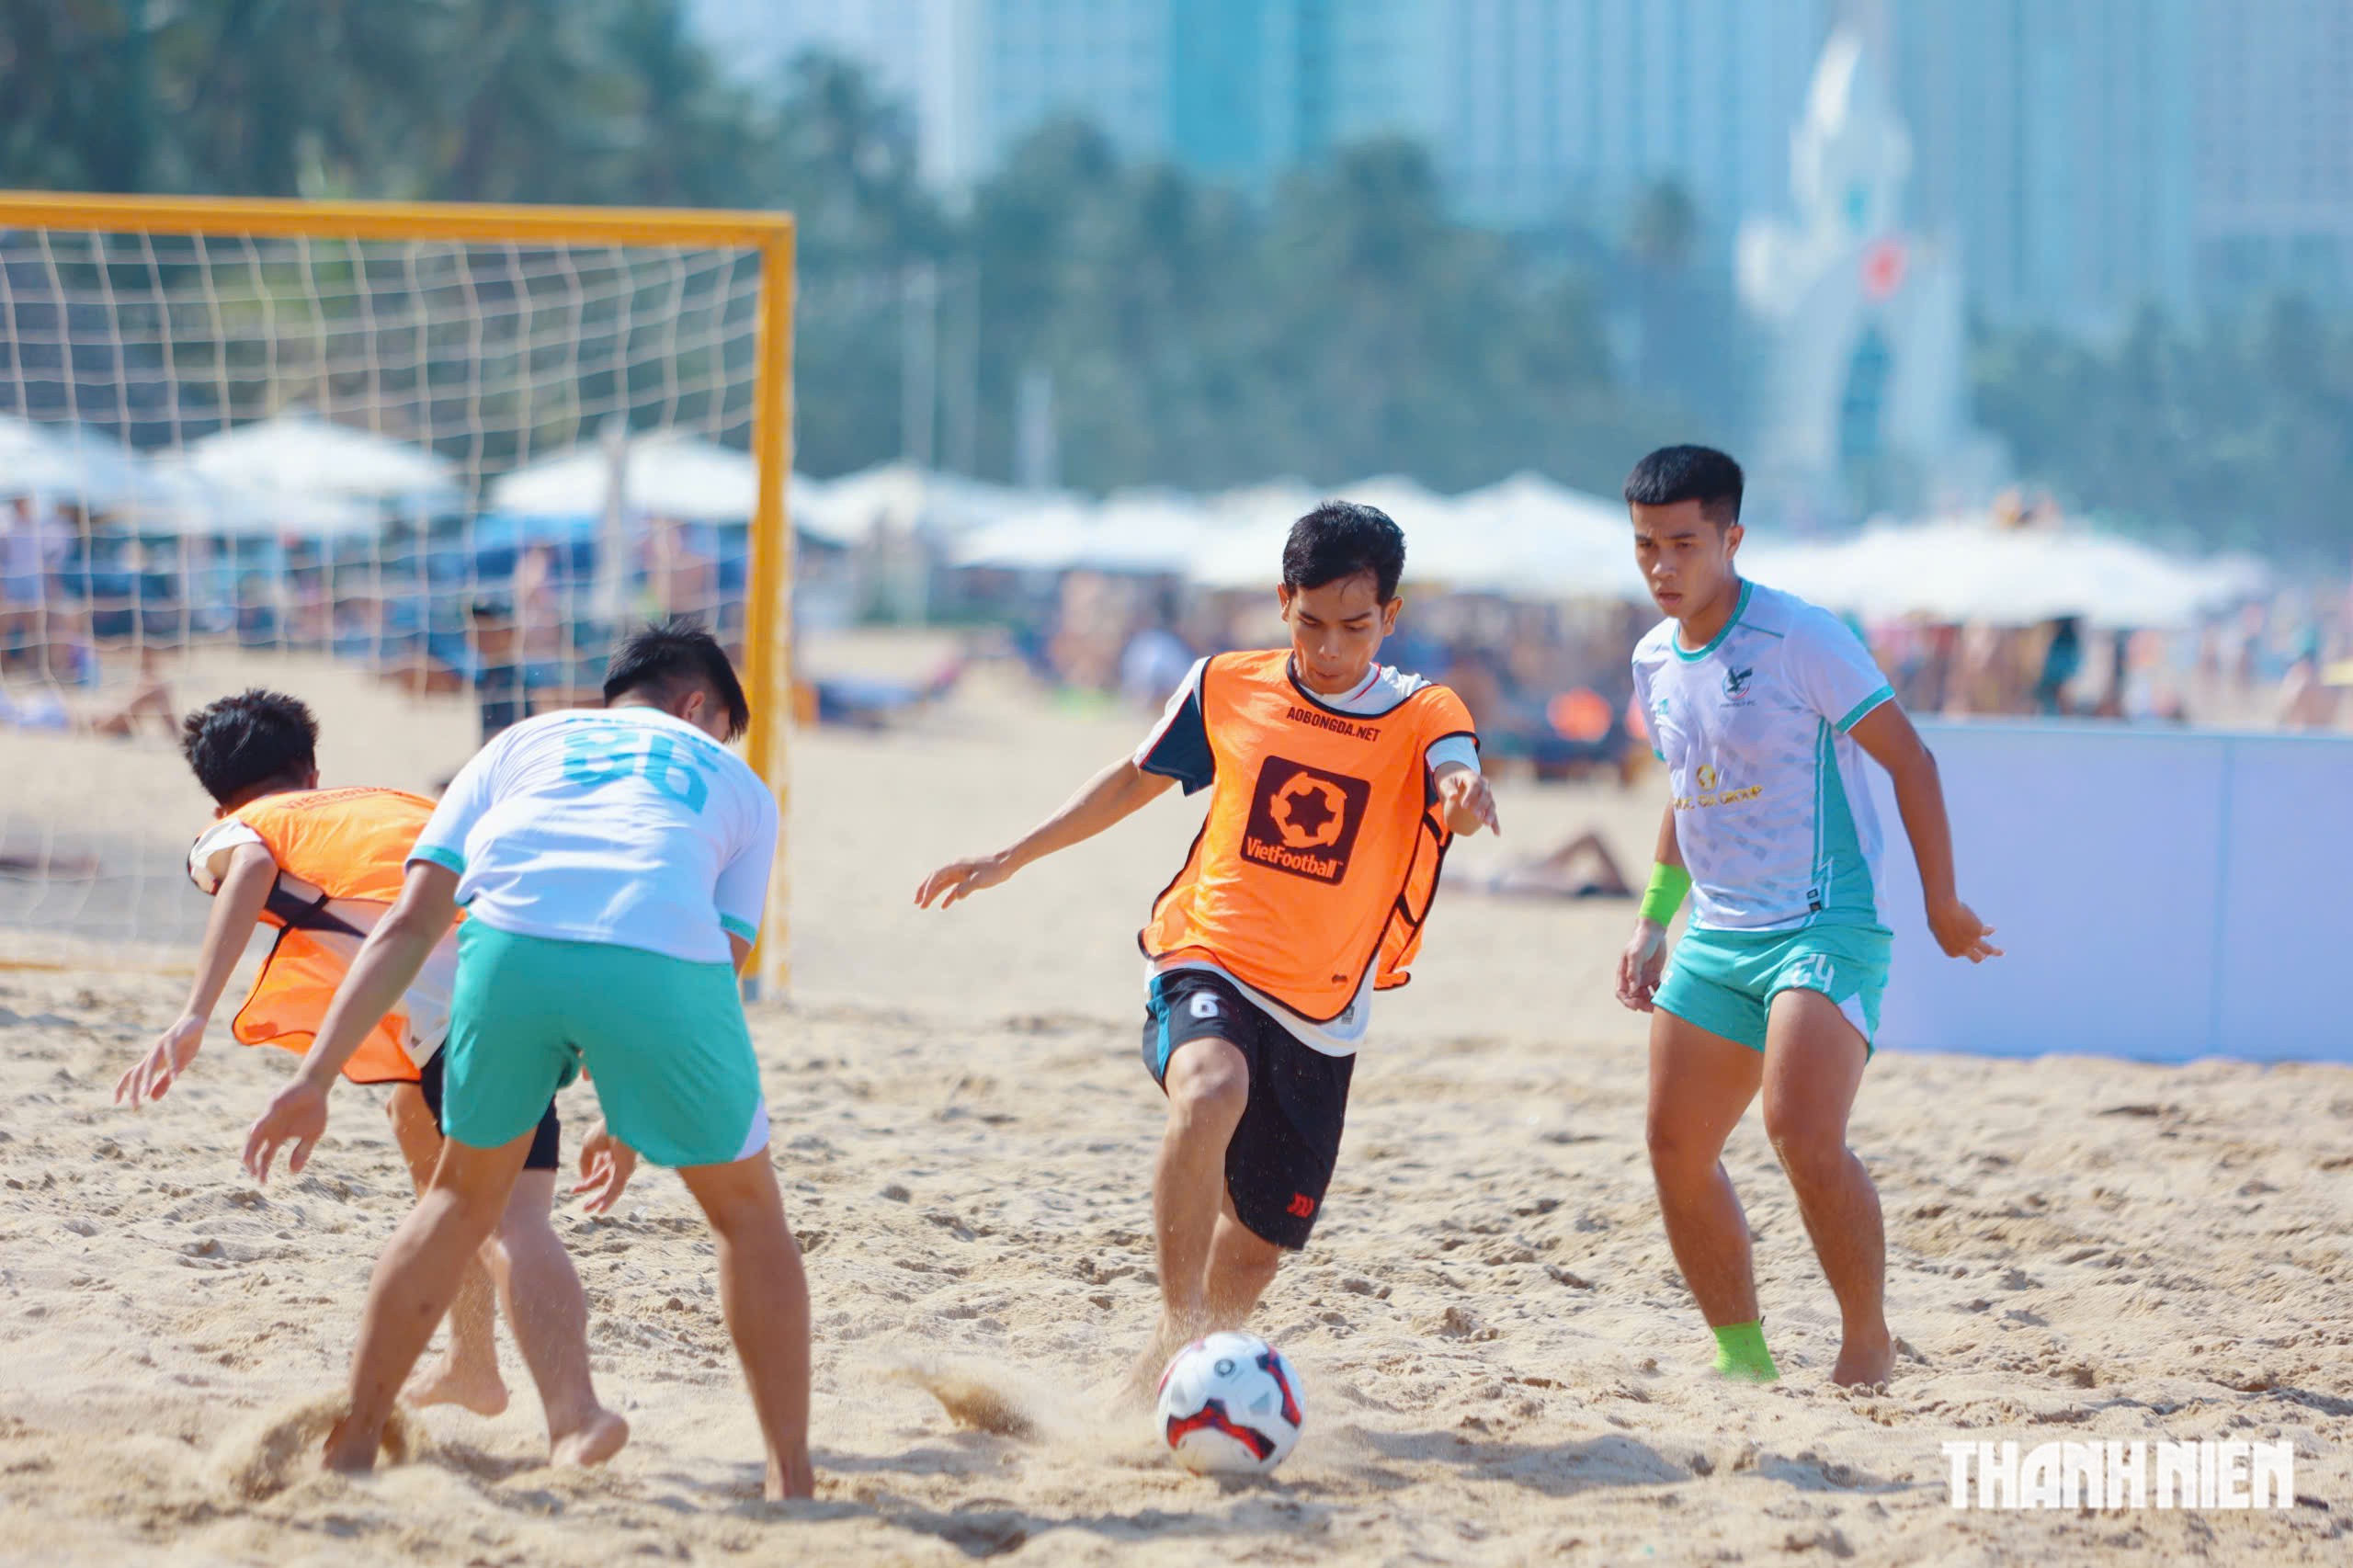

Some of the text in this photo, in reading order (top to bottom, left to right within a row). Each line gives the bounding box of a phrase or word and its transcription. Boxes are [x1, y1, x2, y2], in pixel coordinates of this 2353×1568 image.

[1287, 707, 1381, 742] AOBONGDA.NET
[1246, 836, 1336, 878] VietFootball
[1190, 992, 1220, 1018] 6
